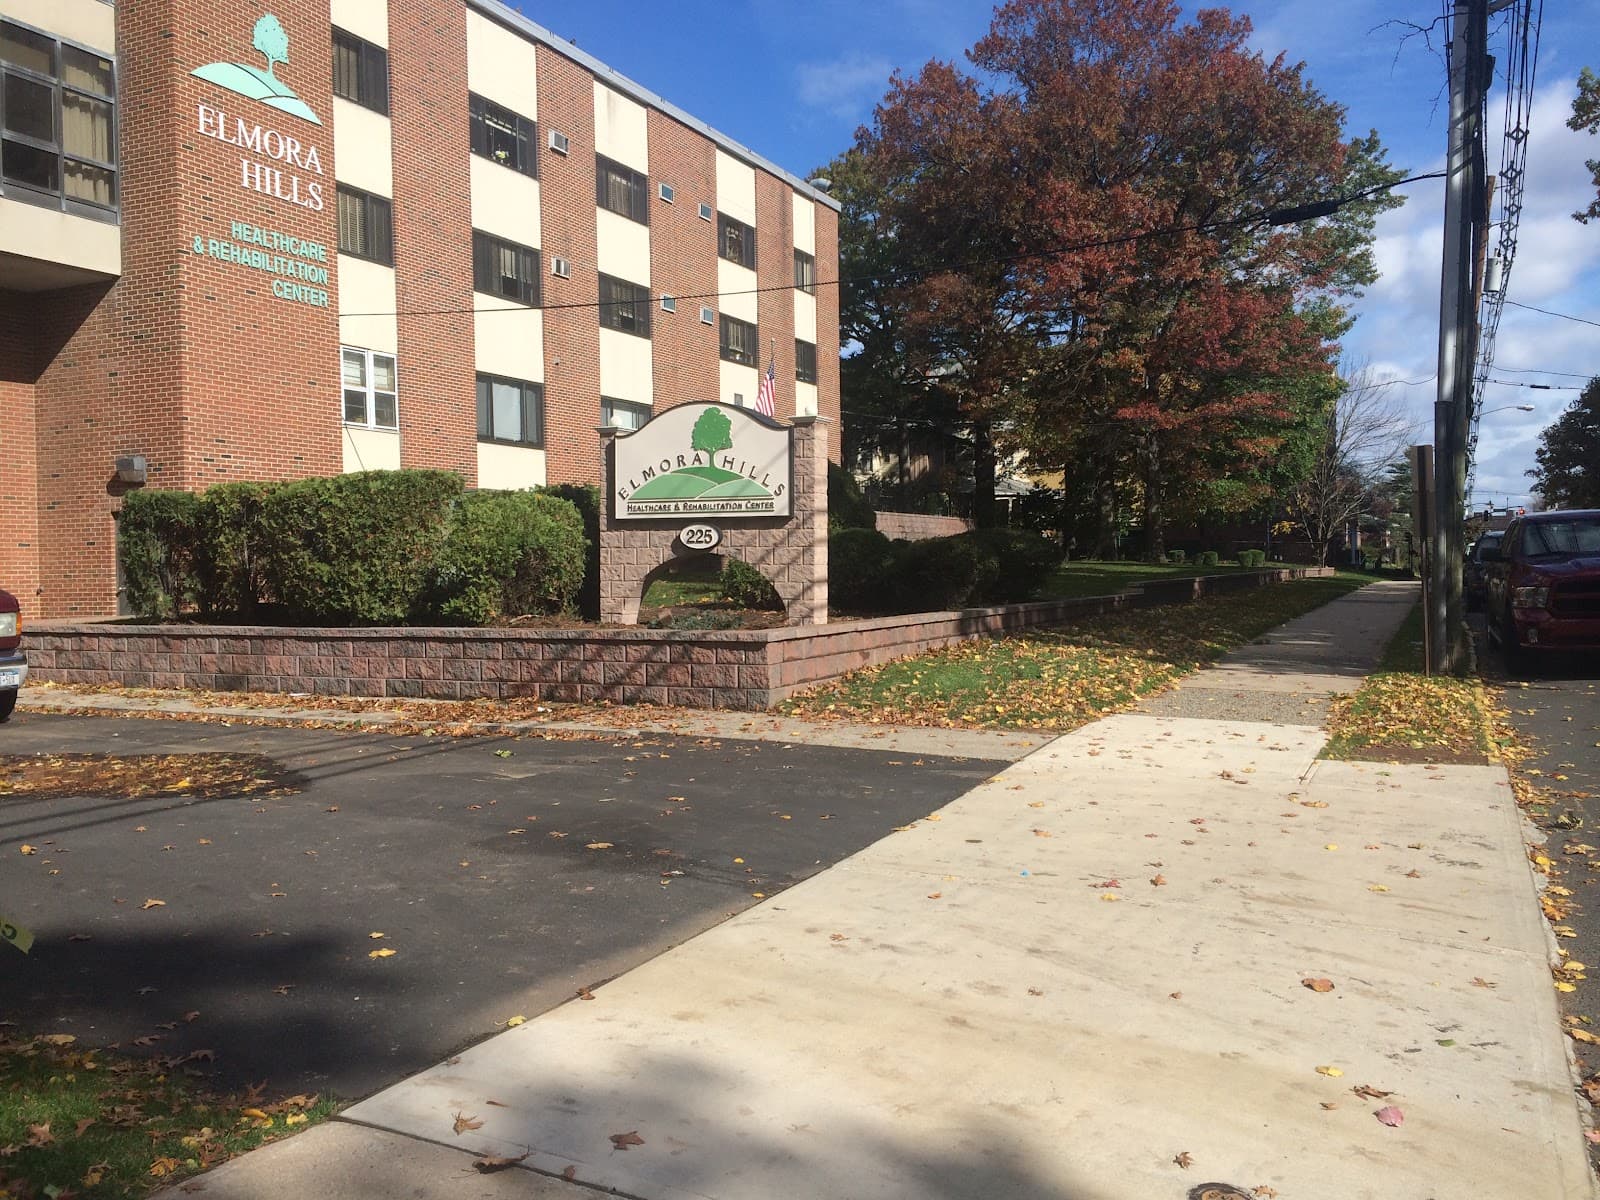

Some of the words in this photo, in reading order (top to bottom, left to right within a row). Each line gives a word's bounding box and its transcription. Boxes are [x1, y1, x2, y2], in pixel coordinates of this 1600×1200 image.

[196, 104, 323, 175] ELMORA
[240, 157, 323, 211] HILLS
[192, 235, 203, 254] &
[208, 238, 327, 285] REHABILITATION
[231, 221, 326, 262] HEALTHCARE
[272, 279, 327, 307] CENTER
[618, 452, 703, 500] ELMORA
[722, 455, 785, 497] HILLS
[627, 503, 671, 512] HEALTHCARE
[673, 502, 680, 511] &
[683, 502, 742, 511] REHABILITATION
[745, 500, 774, 509] CENTER
[686, 529, 713, 544] 225
